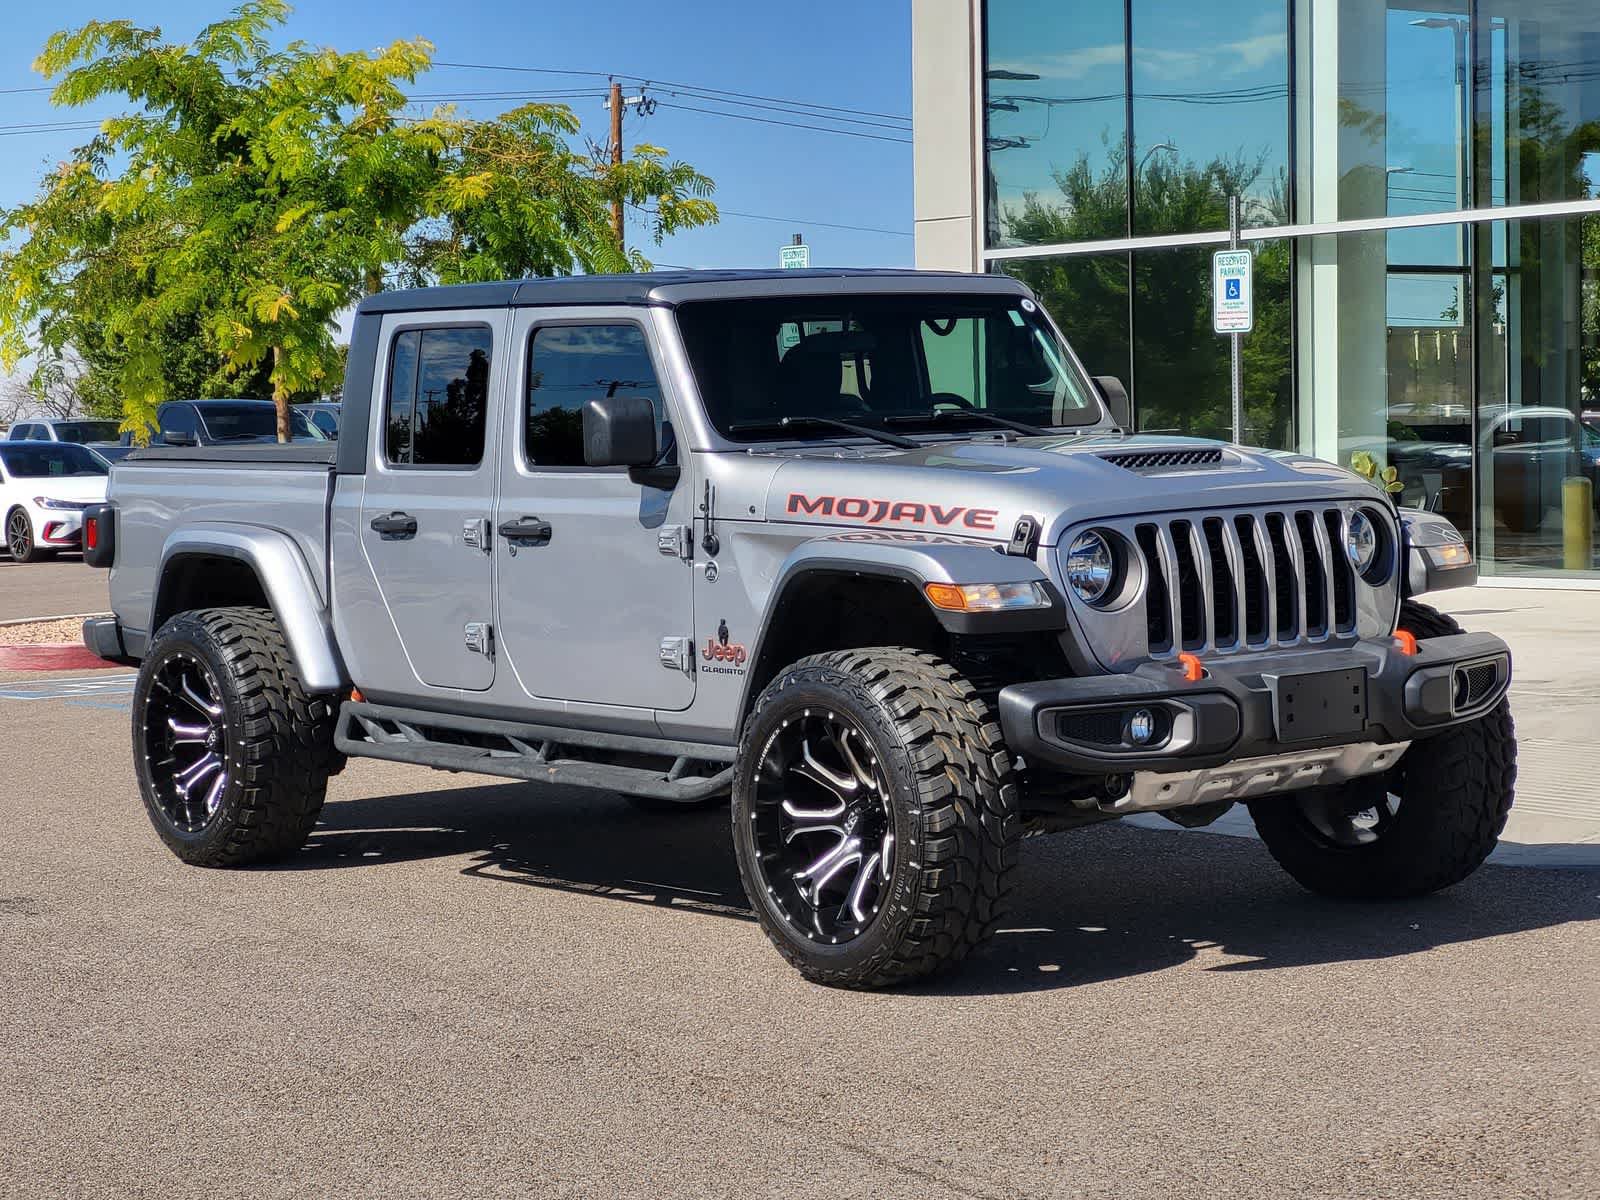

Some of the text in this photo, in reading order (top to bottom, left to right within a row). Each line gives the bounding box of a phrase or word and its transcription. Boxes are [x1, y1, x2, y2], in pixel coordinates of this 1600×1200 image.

[783, 250, 806, 259] RESERVED
[1218, 255, 1248, 266] RESERVED
[1220, 267, 1246, 277] PARKING
[787, 493, 999, 531] MOJAVE
[702, 639, 747, 667] Jeep
[701, 665, 746, 675] GLADIATO
